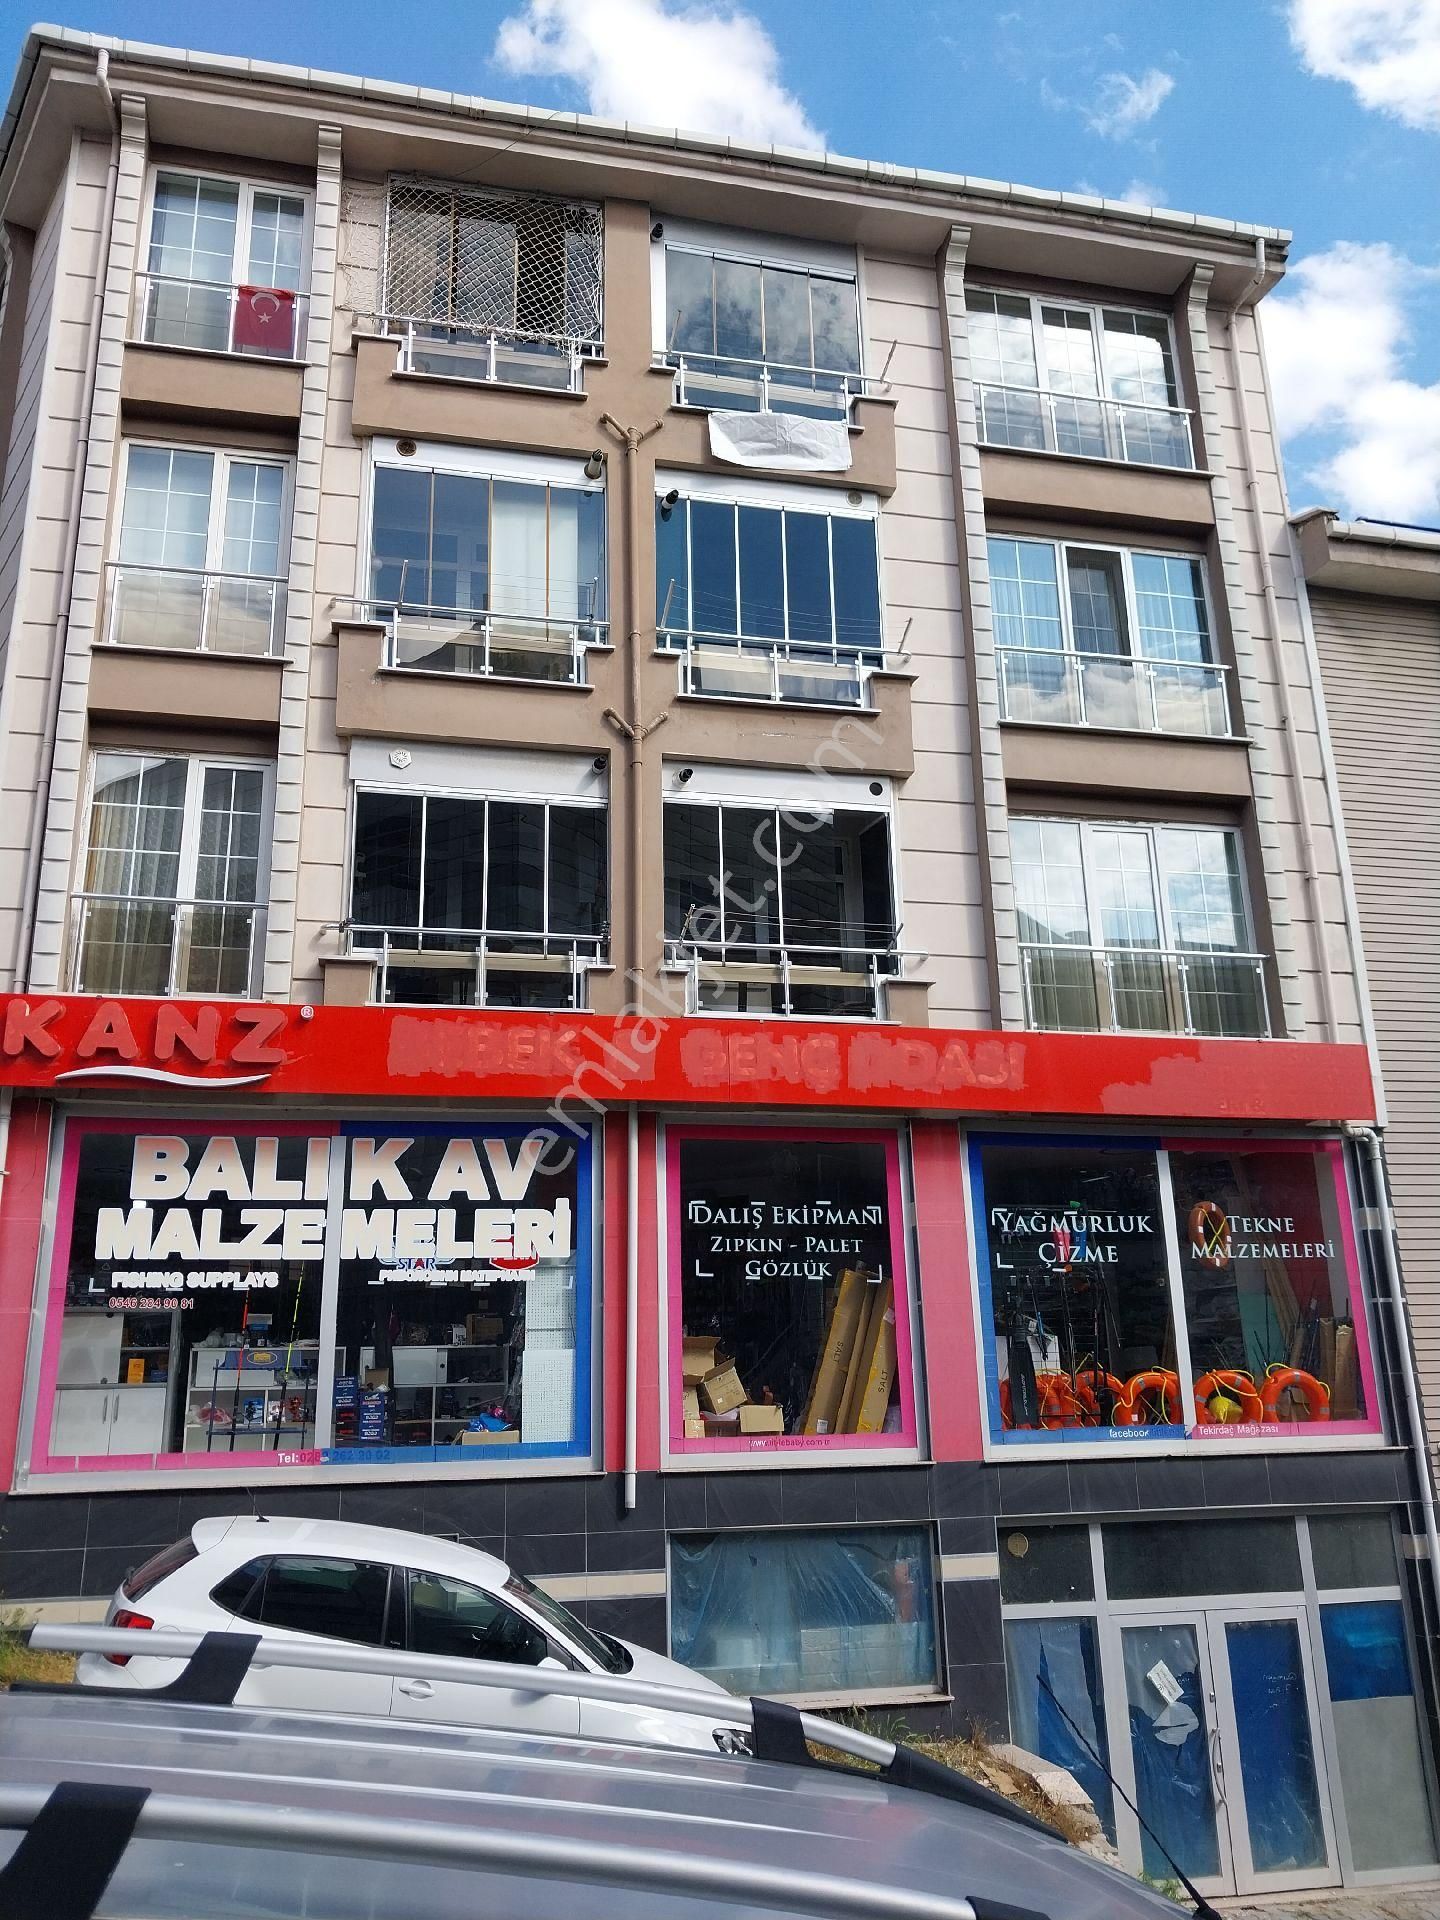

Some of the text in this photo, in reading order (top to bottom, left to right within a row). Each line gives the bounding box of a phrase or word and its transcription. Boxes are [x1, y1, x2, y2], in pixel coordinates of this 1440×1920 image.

[3, 998, 287, 1063] KANZ
[130, 1135, 544, 1201] BALIK AV
[692, 1205, 763, 1229] DALIŞ
[997, 1210, 1154, 1234] YAĞMURLUK
[1229, 1215, 1295, 1234] TEKNE
[95, 1197, 572, 1261] MALZEMELERİ
[710, 1236, 783, 1253] ZIPKIN
[805, 1236, 864, 1253] PALET
[1191, 1239, 1336, 1259] MALZEMELERİ
[1038, 1242, 1119, 1268] ÇİZME
[745, 1259, 833, 1277] GÖZLÜK
[186, 1272, 279, 1288] SUPPLAYS
[180, 1298, 194, 1309] 81
[877, 1369, 888, 1393] SALT
[1109, 1428, 1149, 1438] facebook
[1199, 1424, 1279, 1437] Tekirdağ Mağazası
